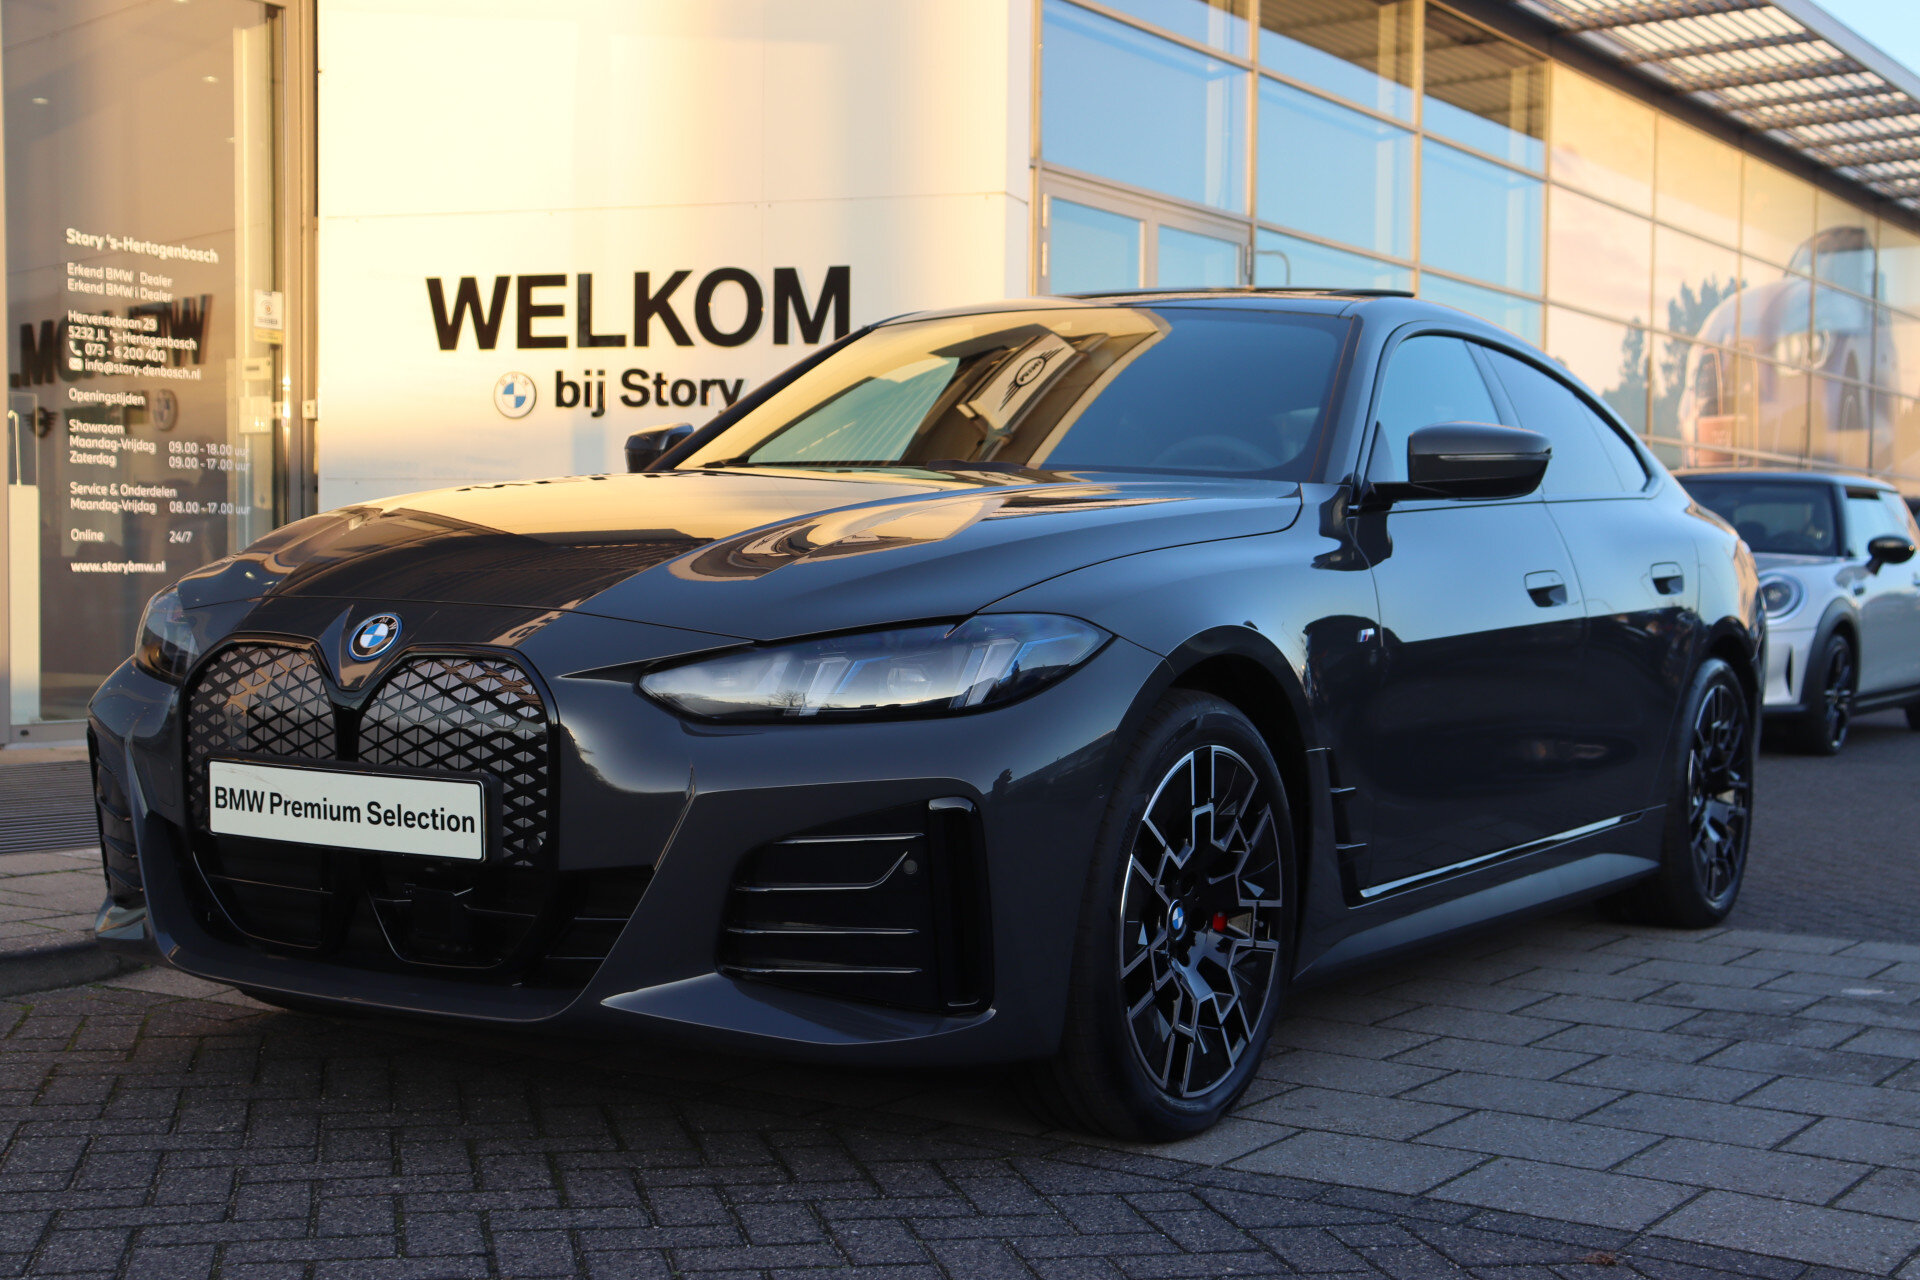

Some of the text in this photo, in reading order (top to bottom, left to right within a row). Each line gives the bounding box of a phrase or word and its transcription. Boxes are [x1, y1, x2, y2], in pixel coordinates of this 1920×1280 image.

[66, 228, 219, 264] Story 's-Hertogenbosch
[67, 262, 173, 287] Erkend BMW Dealer
[67, 278, 173, 302] Erkend BMW i Dealer
[426, 265, 851, 351] WELKOM
[68, 310, 158, 332] Hervensebaan 29
[68, 326, 197, 350] 5232 JL 's-Hertogenbosch
[84, 342, 105, 357] 073
[122, 346, 144, 360] 200
[146, 349, 167, 362] 400
[85, 358, 200, 380] info@story-denbosch.nl
[68, 388, 146, 406] Openingstijden
[555, 368, 744, 417] bij Story
[69, 419, 124, 434] Showroom
[69, 435, 156, 454] Maandag-Vrijdag
[168, 441, 198, 454] 09.00
[206, 444, 233, 456] 18.00
[70, 450, 117, 468] Zaterdag
[168, 456, 198, 469] 09.00
[206, 458, 233, 471] 17.00
[70, 482, 177, 498] Service & Onderdelen
[70, 498, 157, 515] Maandag-Vrijdag
[169, 501, 199, 514] 08.00
[207, 502, 234, 514] 17.00
[236, 506, 251, 515] uur
[70, 528, 193, 544] Online 24/7
[70, 560, 166, 574] www.storybmw.nl
[215, 786, 475, 833] BMW Premium Selection
